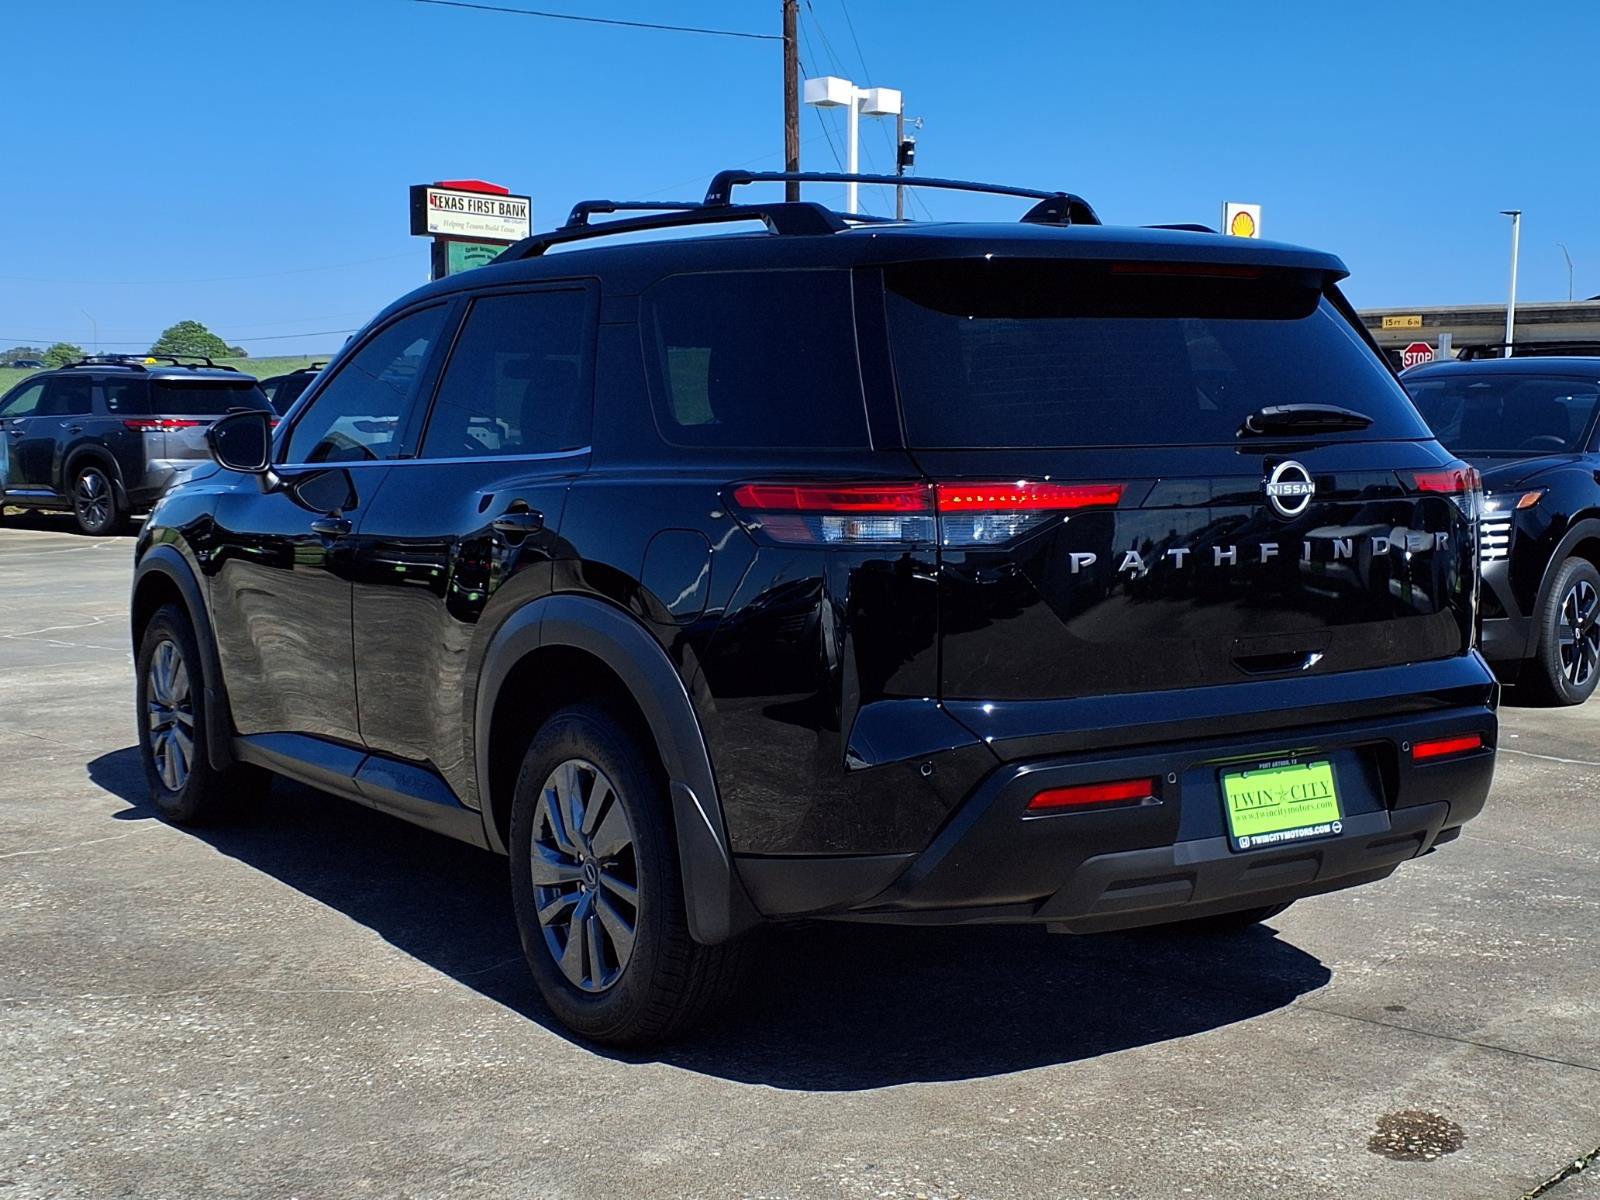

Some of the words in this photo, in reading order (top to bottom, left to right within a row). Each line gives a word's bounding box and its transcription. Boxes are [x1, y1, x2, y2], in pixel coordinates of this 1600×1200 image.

[433, 194, 464, 211] TEXAS
[468, 199, 495, 214] FIRST
[499, 201, 527, 218] BANK
[1405, 352, 1432, 365] STOP
[1267, 483, 1316, 496] NISSAN
[1068, 531, 1450, 575] PATHFINDER
[1230, 788, 1273, 809] TWIN
[1290, 780, 1330, 799] CITY
[1235, 801, 1333, 822] www.twincitymotors.com
[1250, 824, 1331, 845] TWINCITYMOTORS.COM
